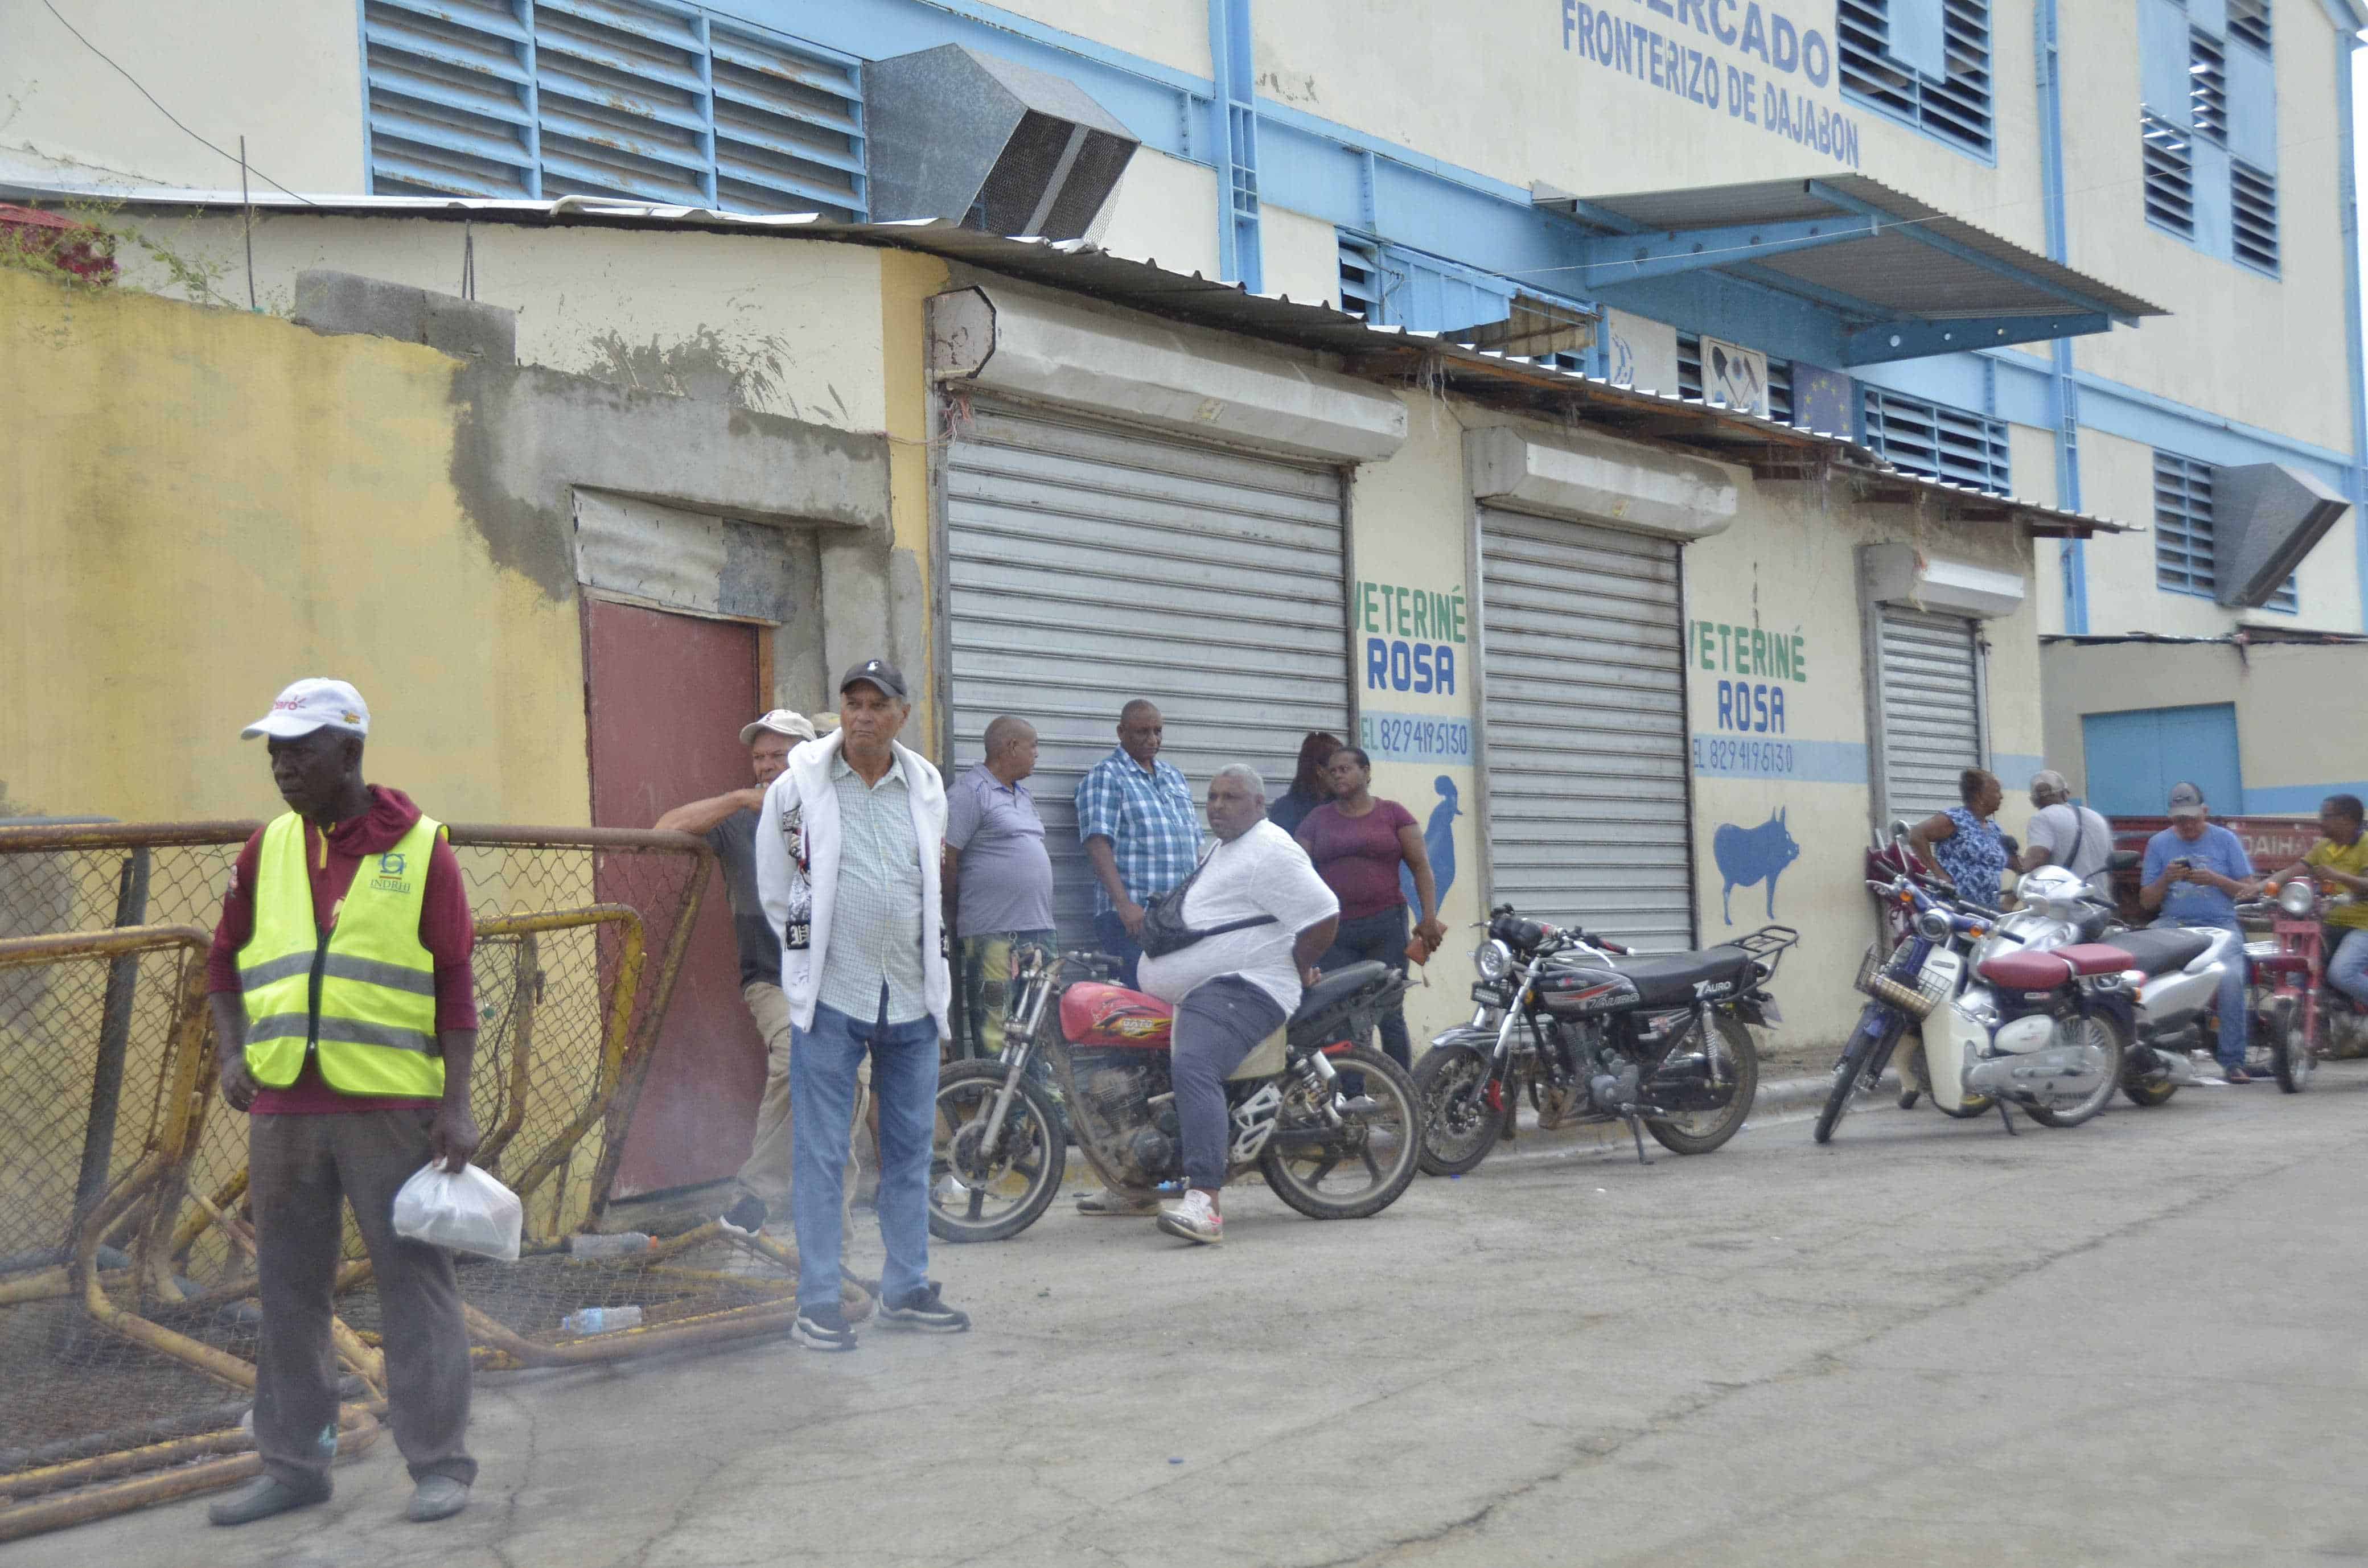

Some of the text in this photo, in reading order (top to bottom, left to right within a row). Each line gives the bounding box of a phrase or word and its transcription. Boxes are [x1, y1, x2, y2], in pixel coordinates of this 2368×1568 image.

[1633, 0, 1830, 88] RCADO
[1562, 0, 1859, 169] FRONTERIZO DE DAJABON
[1367, 637, 1455, 695] ROSA
[1717, 680, 1785, 734] ROSA
[1692, 980, 1732, 998] TAURO
